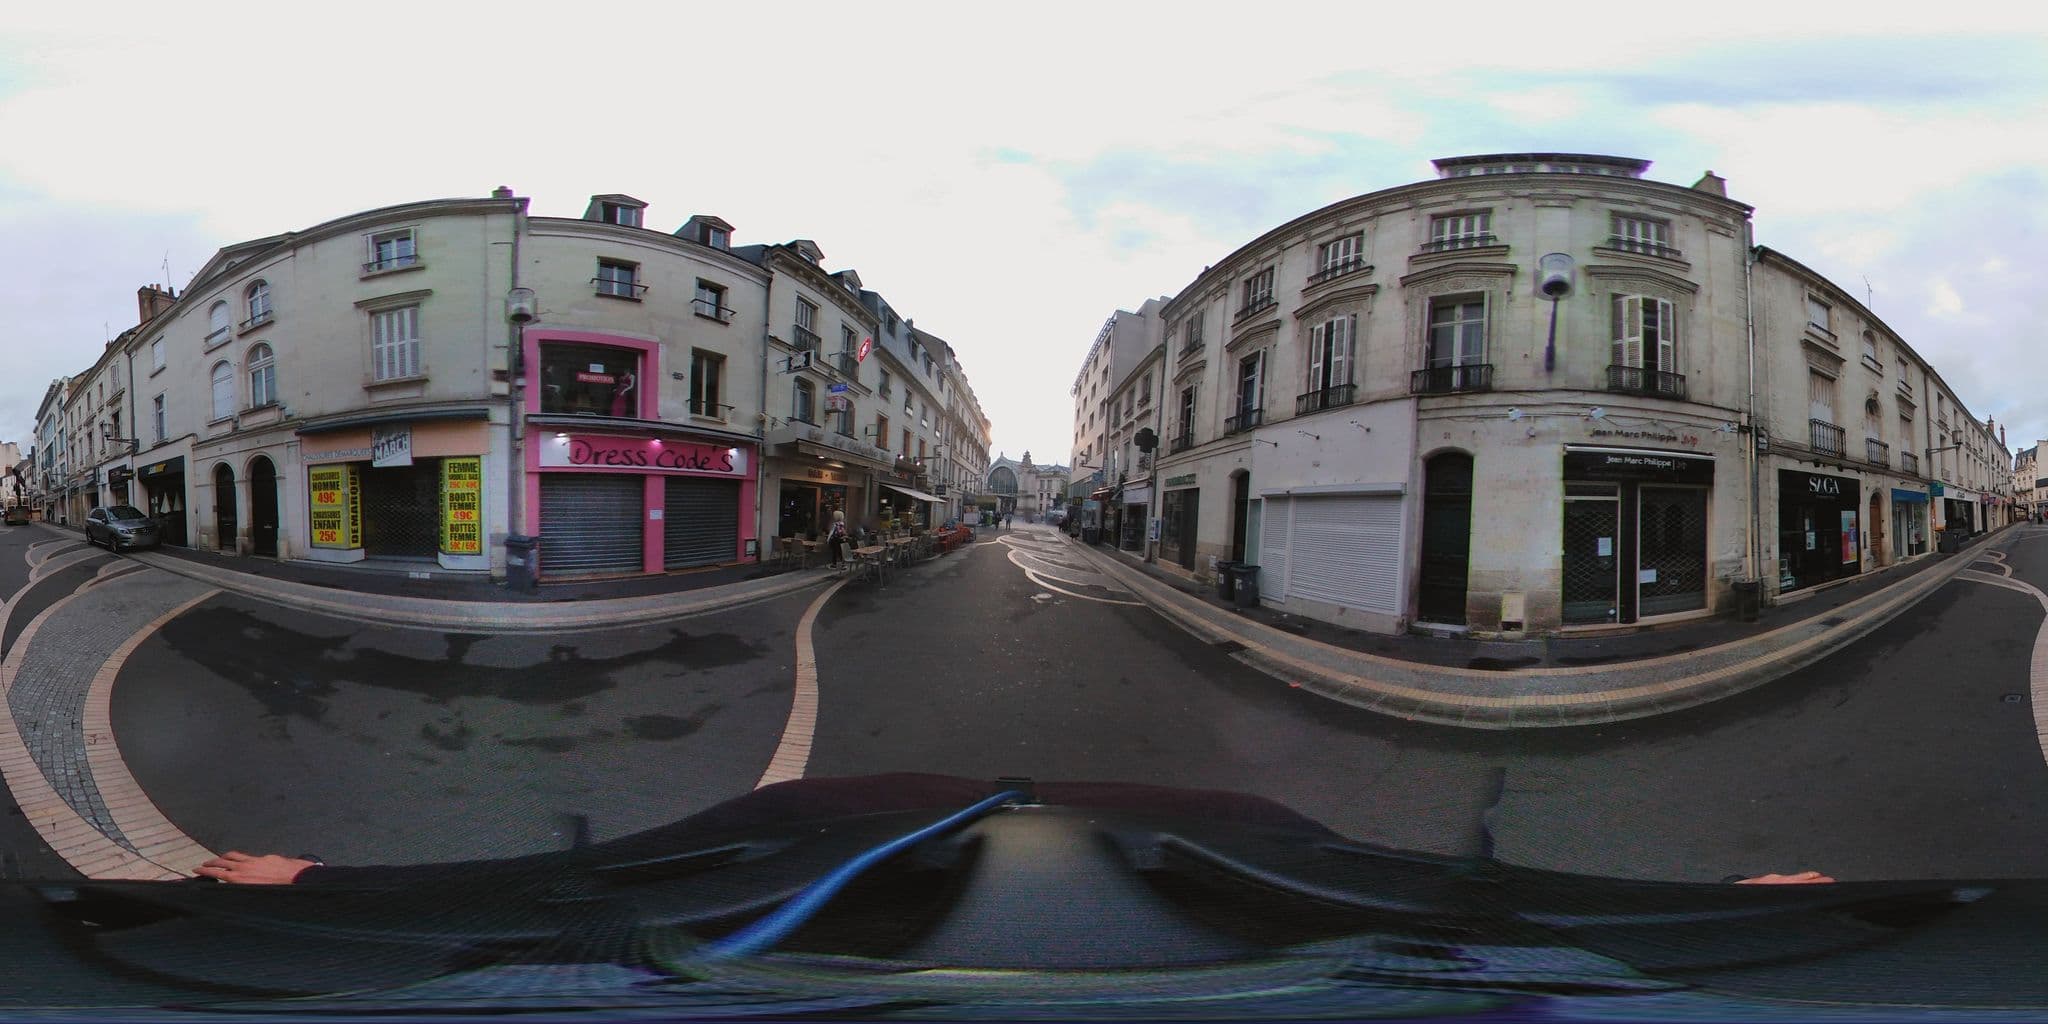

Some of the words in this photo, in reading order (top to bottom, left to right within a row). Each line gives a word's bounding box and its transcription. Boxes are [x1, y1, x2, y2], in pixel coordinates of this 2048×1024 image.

[1641, 431, 1677, 443] Philippe
[562, 440, 648, 466] Dress
[449, 462, 478, 473] FEMME
[1644, 458, 1672, 469] Philippe
[312, 481, 341, 491] HOMME
[1809, 477, 1840, 494] SAGA
[318, 491, 336, 504] 49€
[449, 492, 476, 501] BOOTS
[449, 502, 476, 511] FEMME
[314, 519, 341, 530] ENFANT
[450, 523, 476, 532] BOTTES
[319, 530, 336, 542] 25€
[450, 533, 476, 541] FEMME
